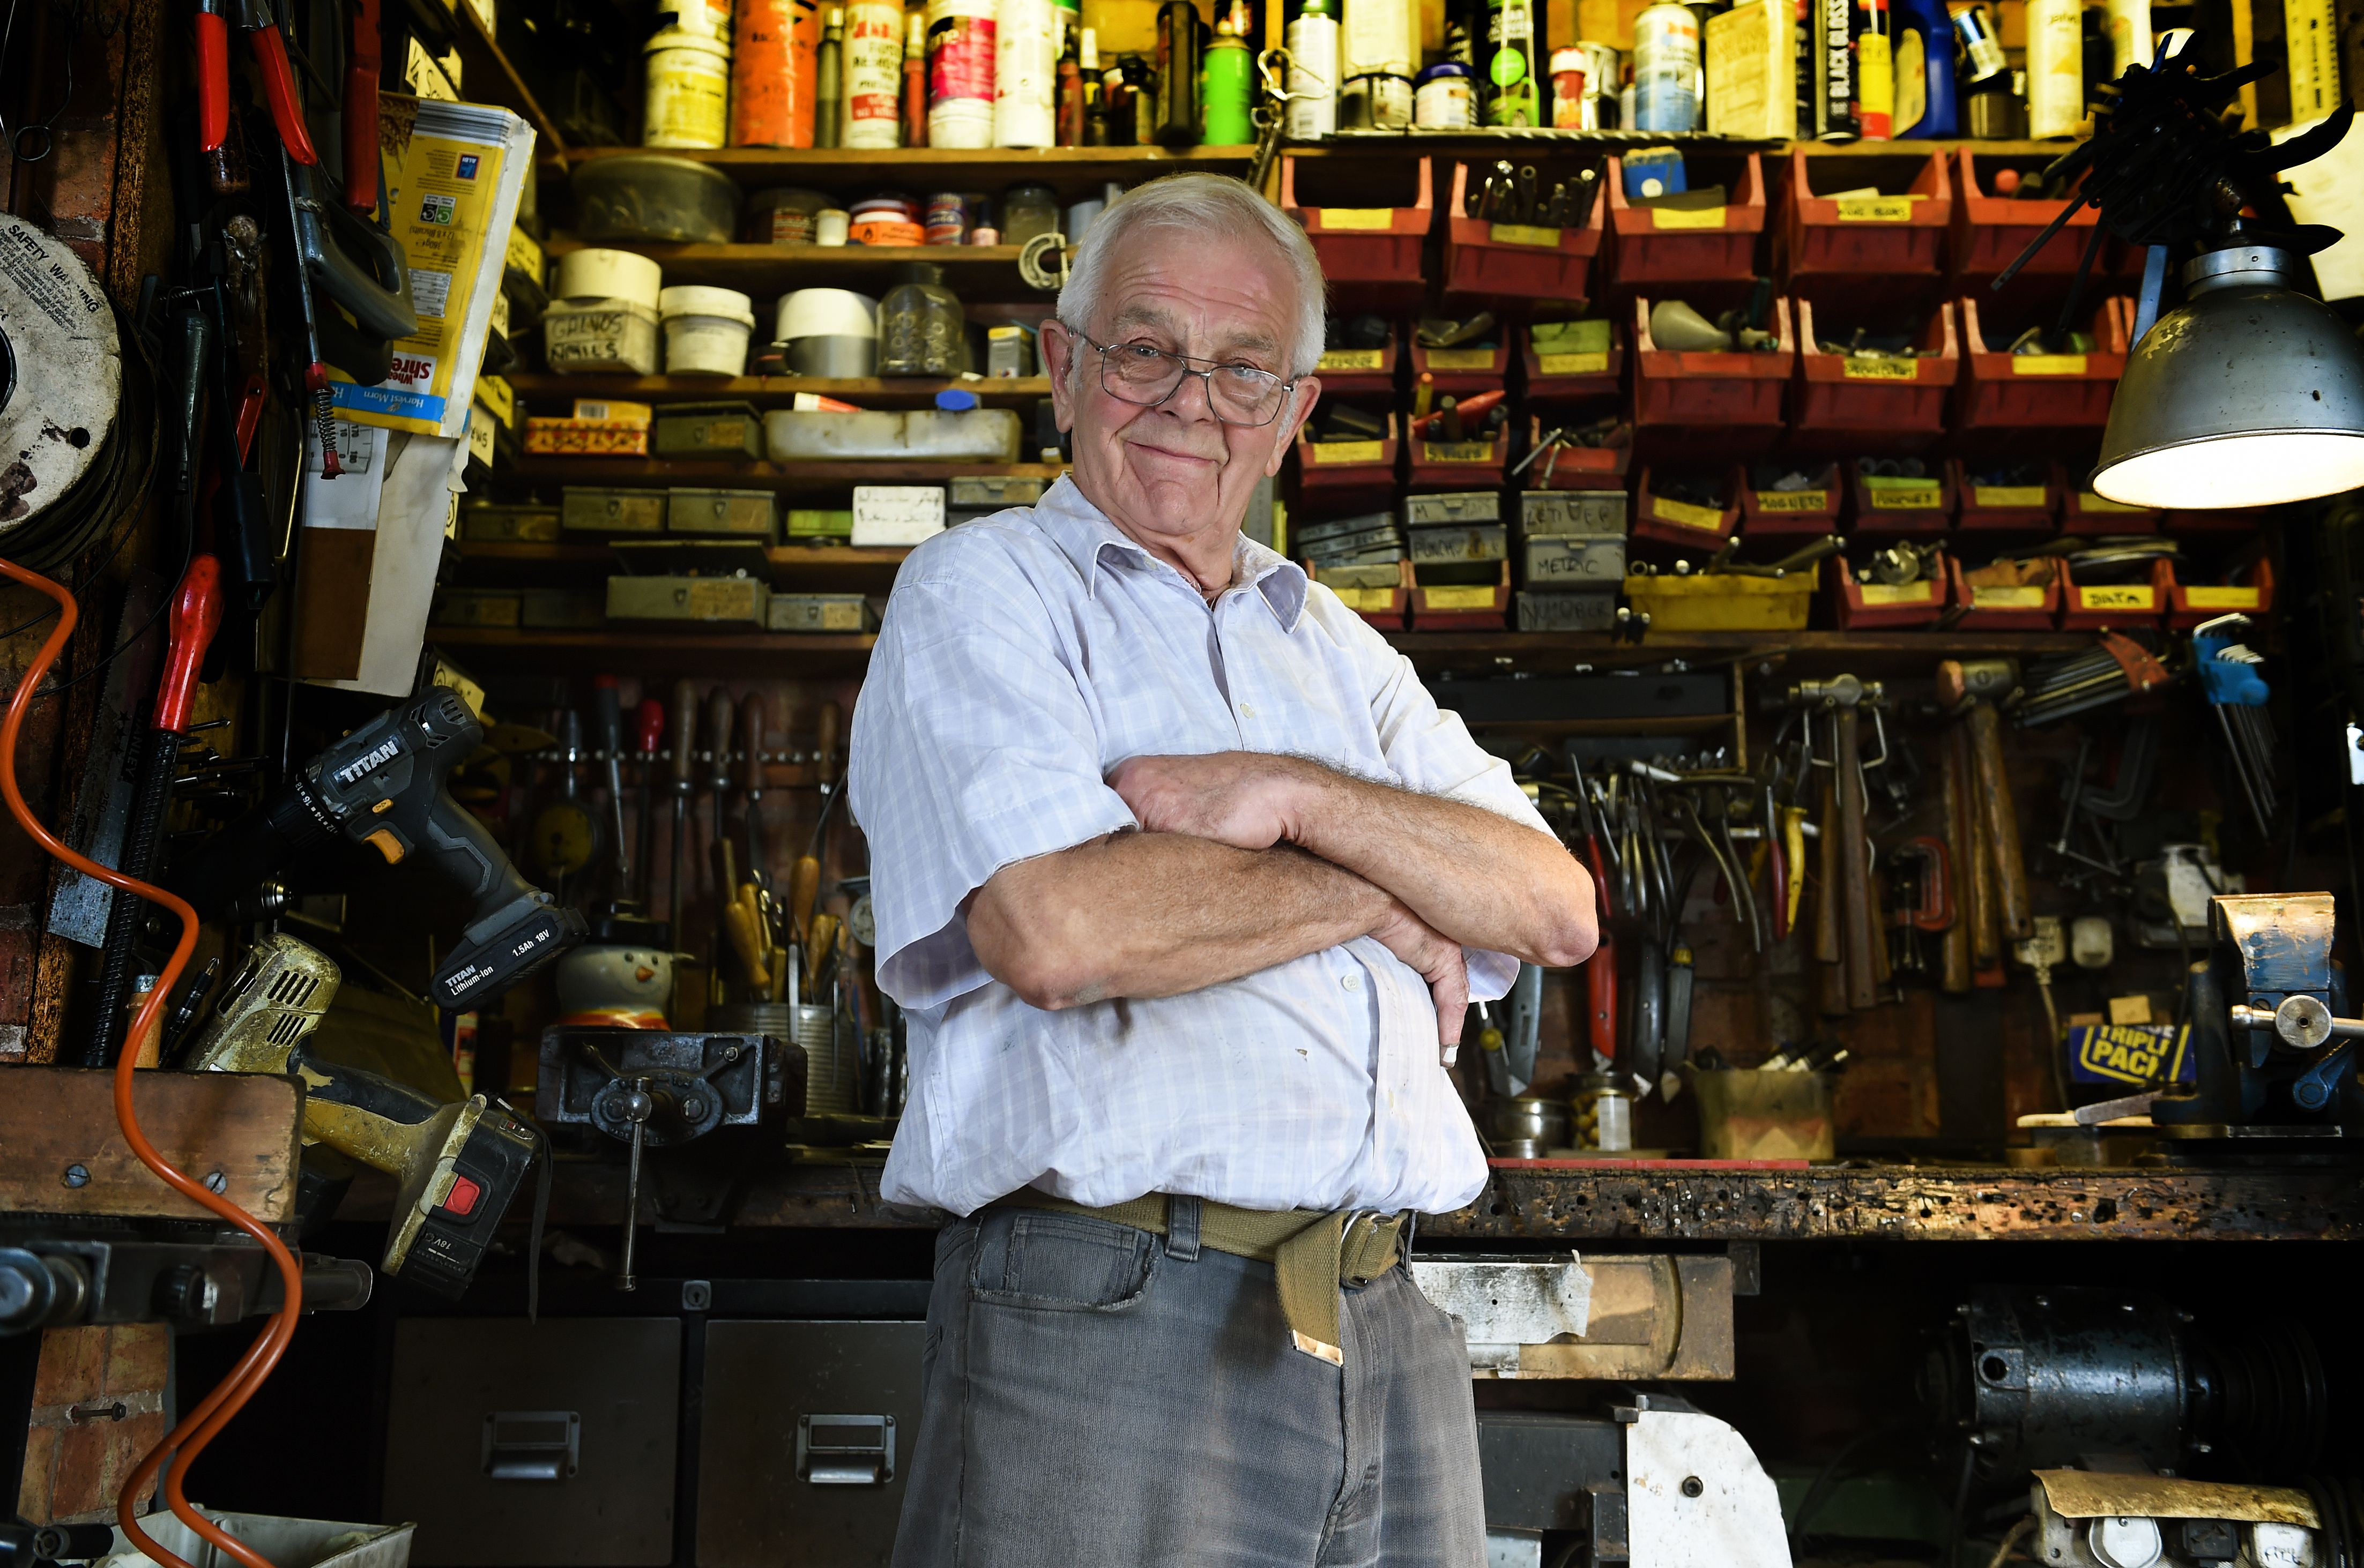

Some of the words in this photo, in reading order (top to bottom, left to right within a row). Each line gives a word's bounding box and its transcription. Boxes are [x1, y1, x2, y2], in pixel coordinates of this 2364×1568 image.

[8, 225, 49, 261] SAFETY
[10, 273, 30, 293] consult
[27, 291, 50, 313] qualified
[388, 371, 413, 385] Whea
[391, 357, 431, 379] Shre
[364, 391, 389, 402] Morn
[391, 394, 424, 408] Harvest
[1538, 556, 1598, 575] METRIC
[340, 740, 399, 782] TITAN
[302, 796, 312, 806] 16
[314, 811, 324, 822] 14
[512, 940, 534, 957] 1.5Ah
[535, 929, 549, 942] 18V
[445, 965, 476, 987] TITAN
[451, 966, 494, 996] Lithium-Ion
[434, 1238, 451, 1250] 18V
